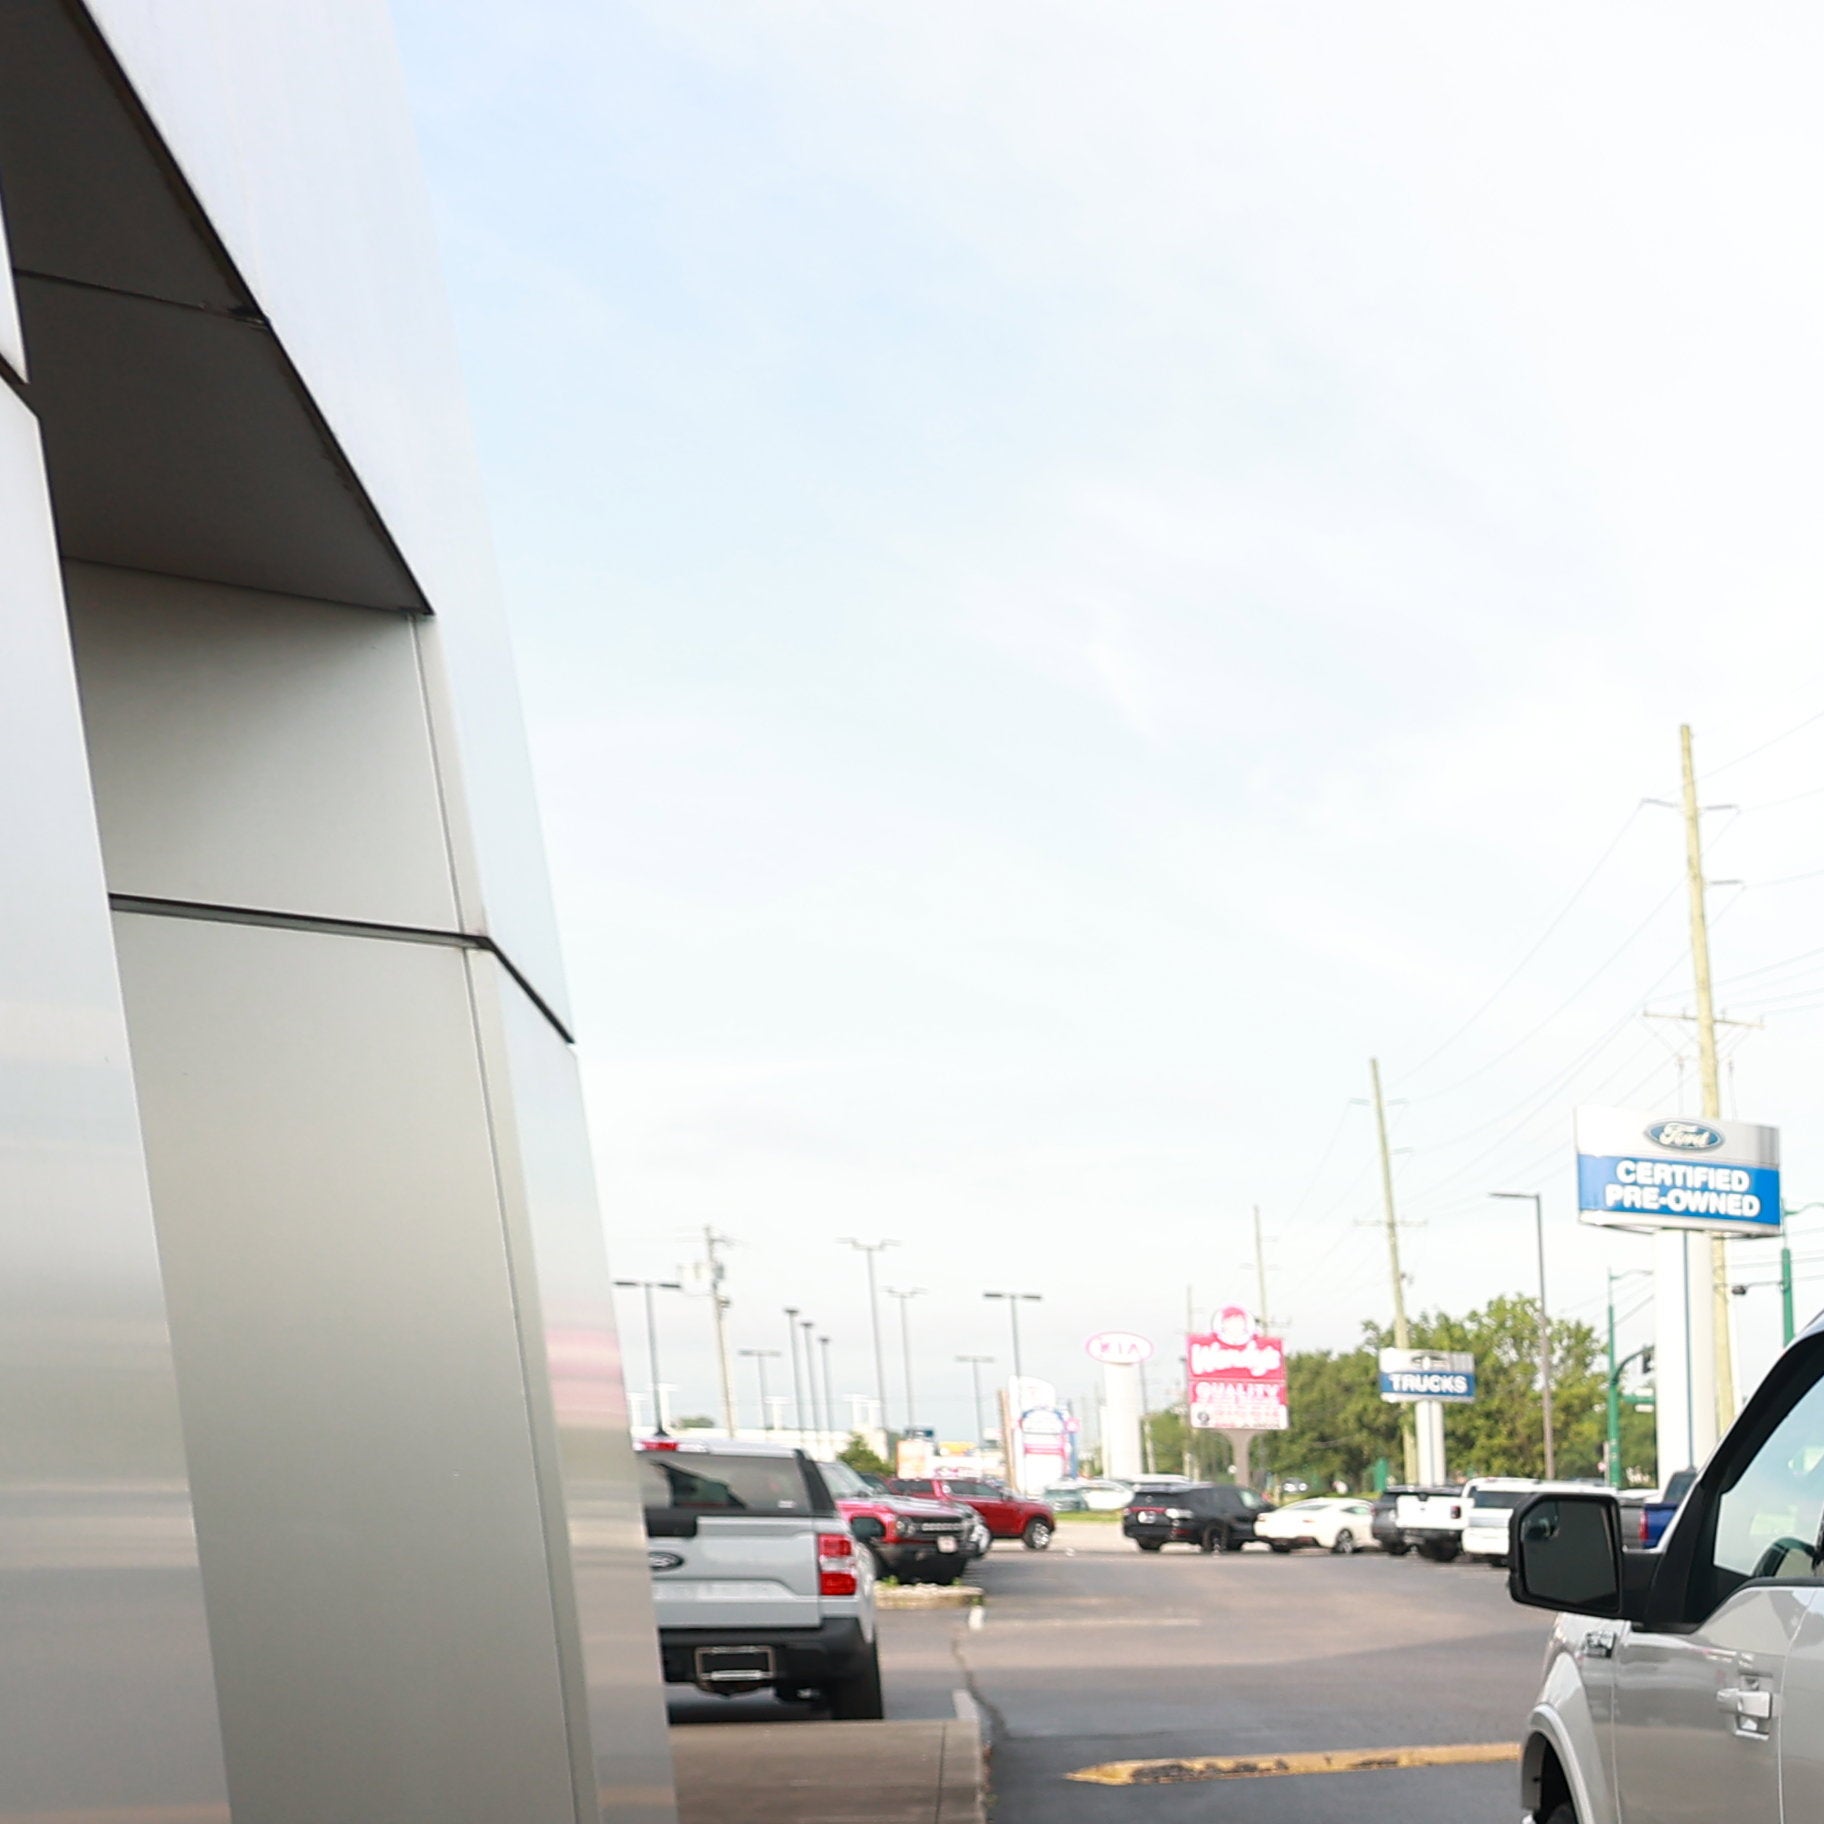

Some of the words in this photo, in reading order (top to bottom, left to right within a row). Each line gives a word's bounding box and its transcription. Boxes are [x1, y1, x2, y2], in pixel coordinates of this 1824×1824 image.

[1659, 1122, 1711, 1149] Ford
[1616, 1160, 1750, 1192] CERTIFIED
[1605, 1184, 1760, 1217] PRE-OWNED
[1388, 1373, 1468, 1394] TRUCKS
